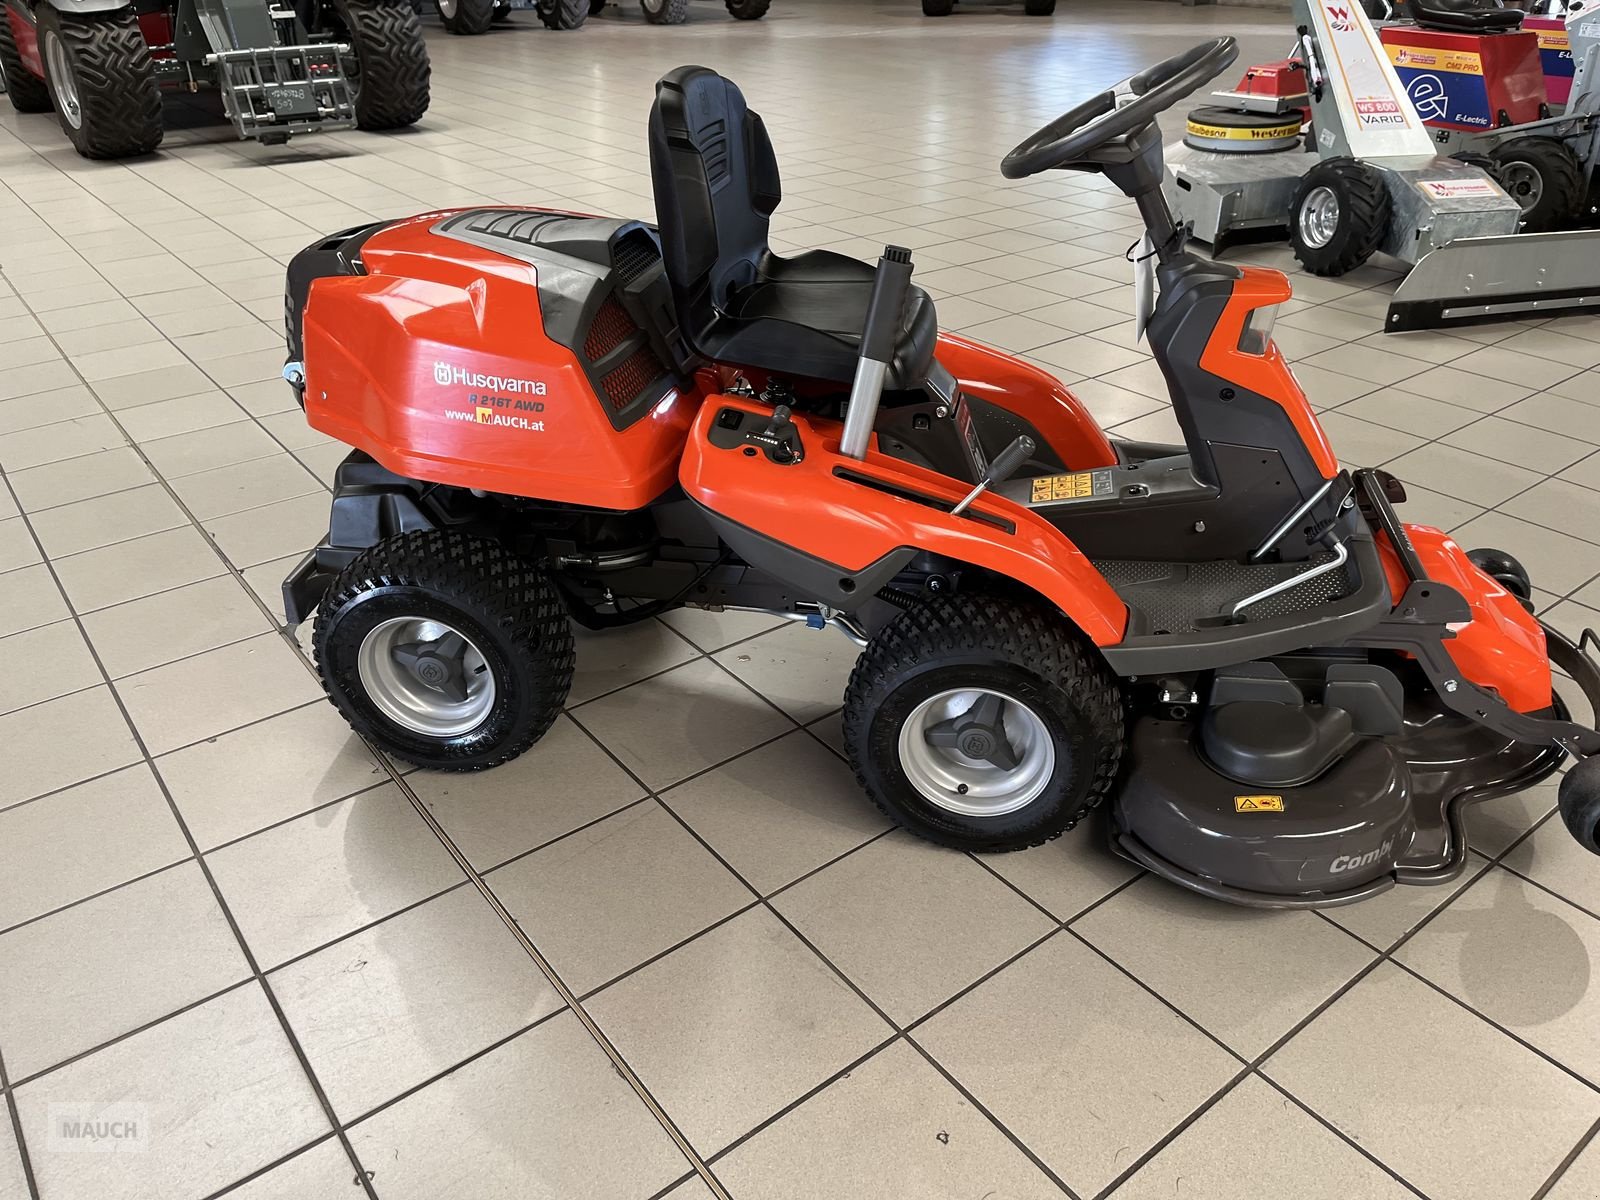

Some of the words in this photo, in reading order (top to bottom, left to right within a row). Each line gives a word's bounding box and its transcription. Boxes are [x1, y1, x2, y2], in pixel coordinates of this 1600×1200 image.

[1462, 64, 1480, 72] PRO
[1357, 102, 1375, 112] WS
[1375, 101, 1396, 112] 800
[1455, 113, 1488, 125] E-Lectric
[453, 367, 547, 396] Husqvarna
[469, 394, 478, 405] R
[481, 395, 512, 409] 216T
[514, 399, 545, 413] AWD
[445, 407, 545, 431] www.MAUCH.at
